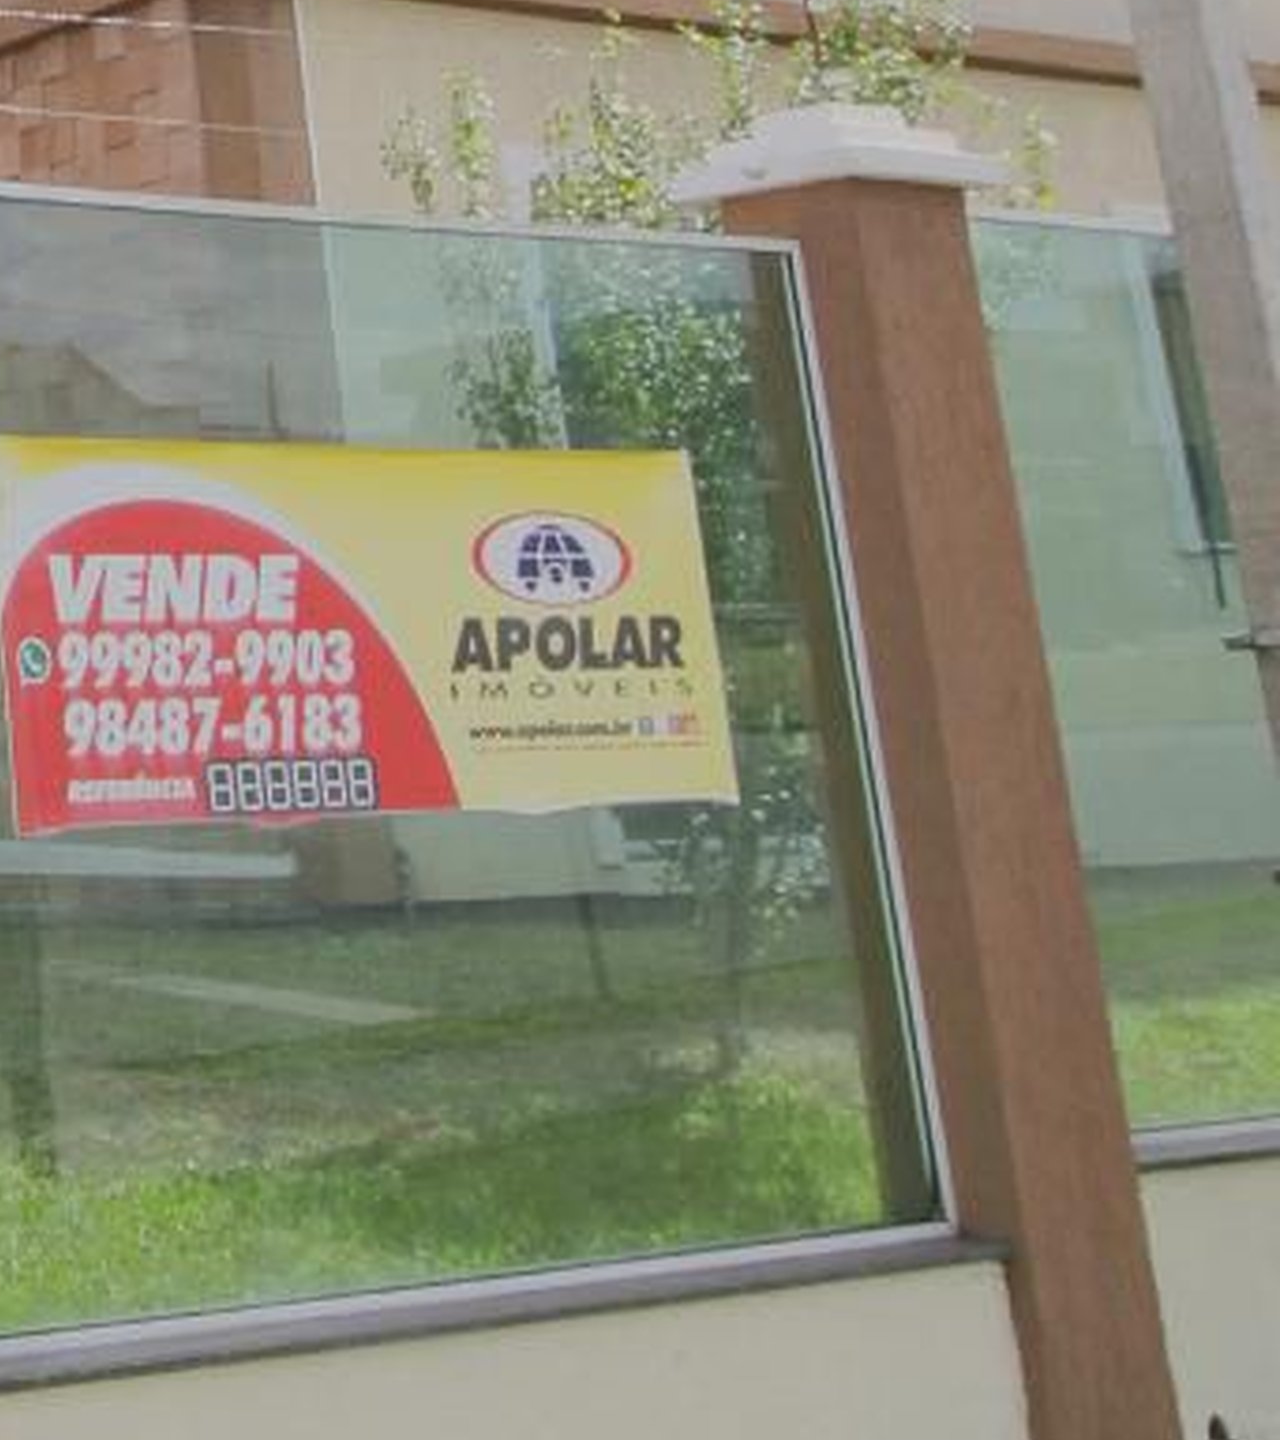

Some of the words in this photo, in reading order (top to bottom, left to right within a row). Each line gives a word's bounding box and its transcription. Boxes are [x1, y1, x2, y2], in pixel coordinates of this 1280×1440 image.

[46, 554, 301, 625] VENDE
[57, 629, 356, 690] 99982-9903
[451, 615, 685, 672] APOLAR
[449, 675, 695, 700] IMÓVEIS
[62, 695, 362, 759] 98487-6183
